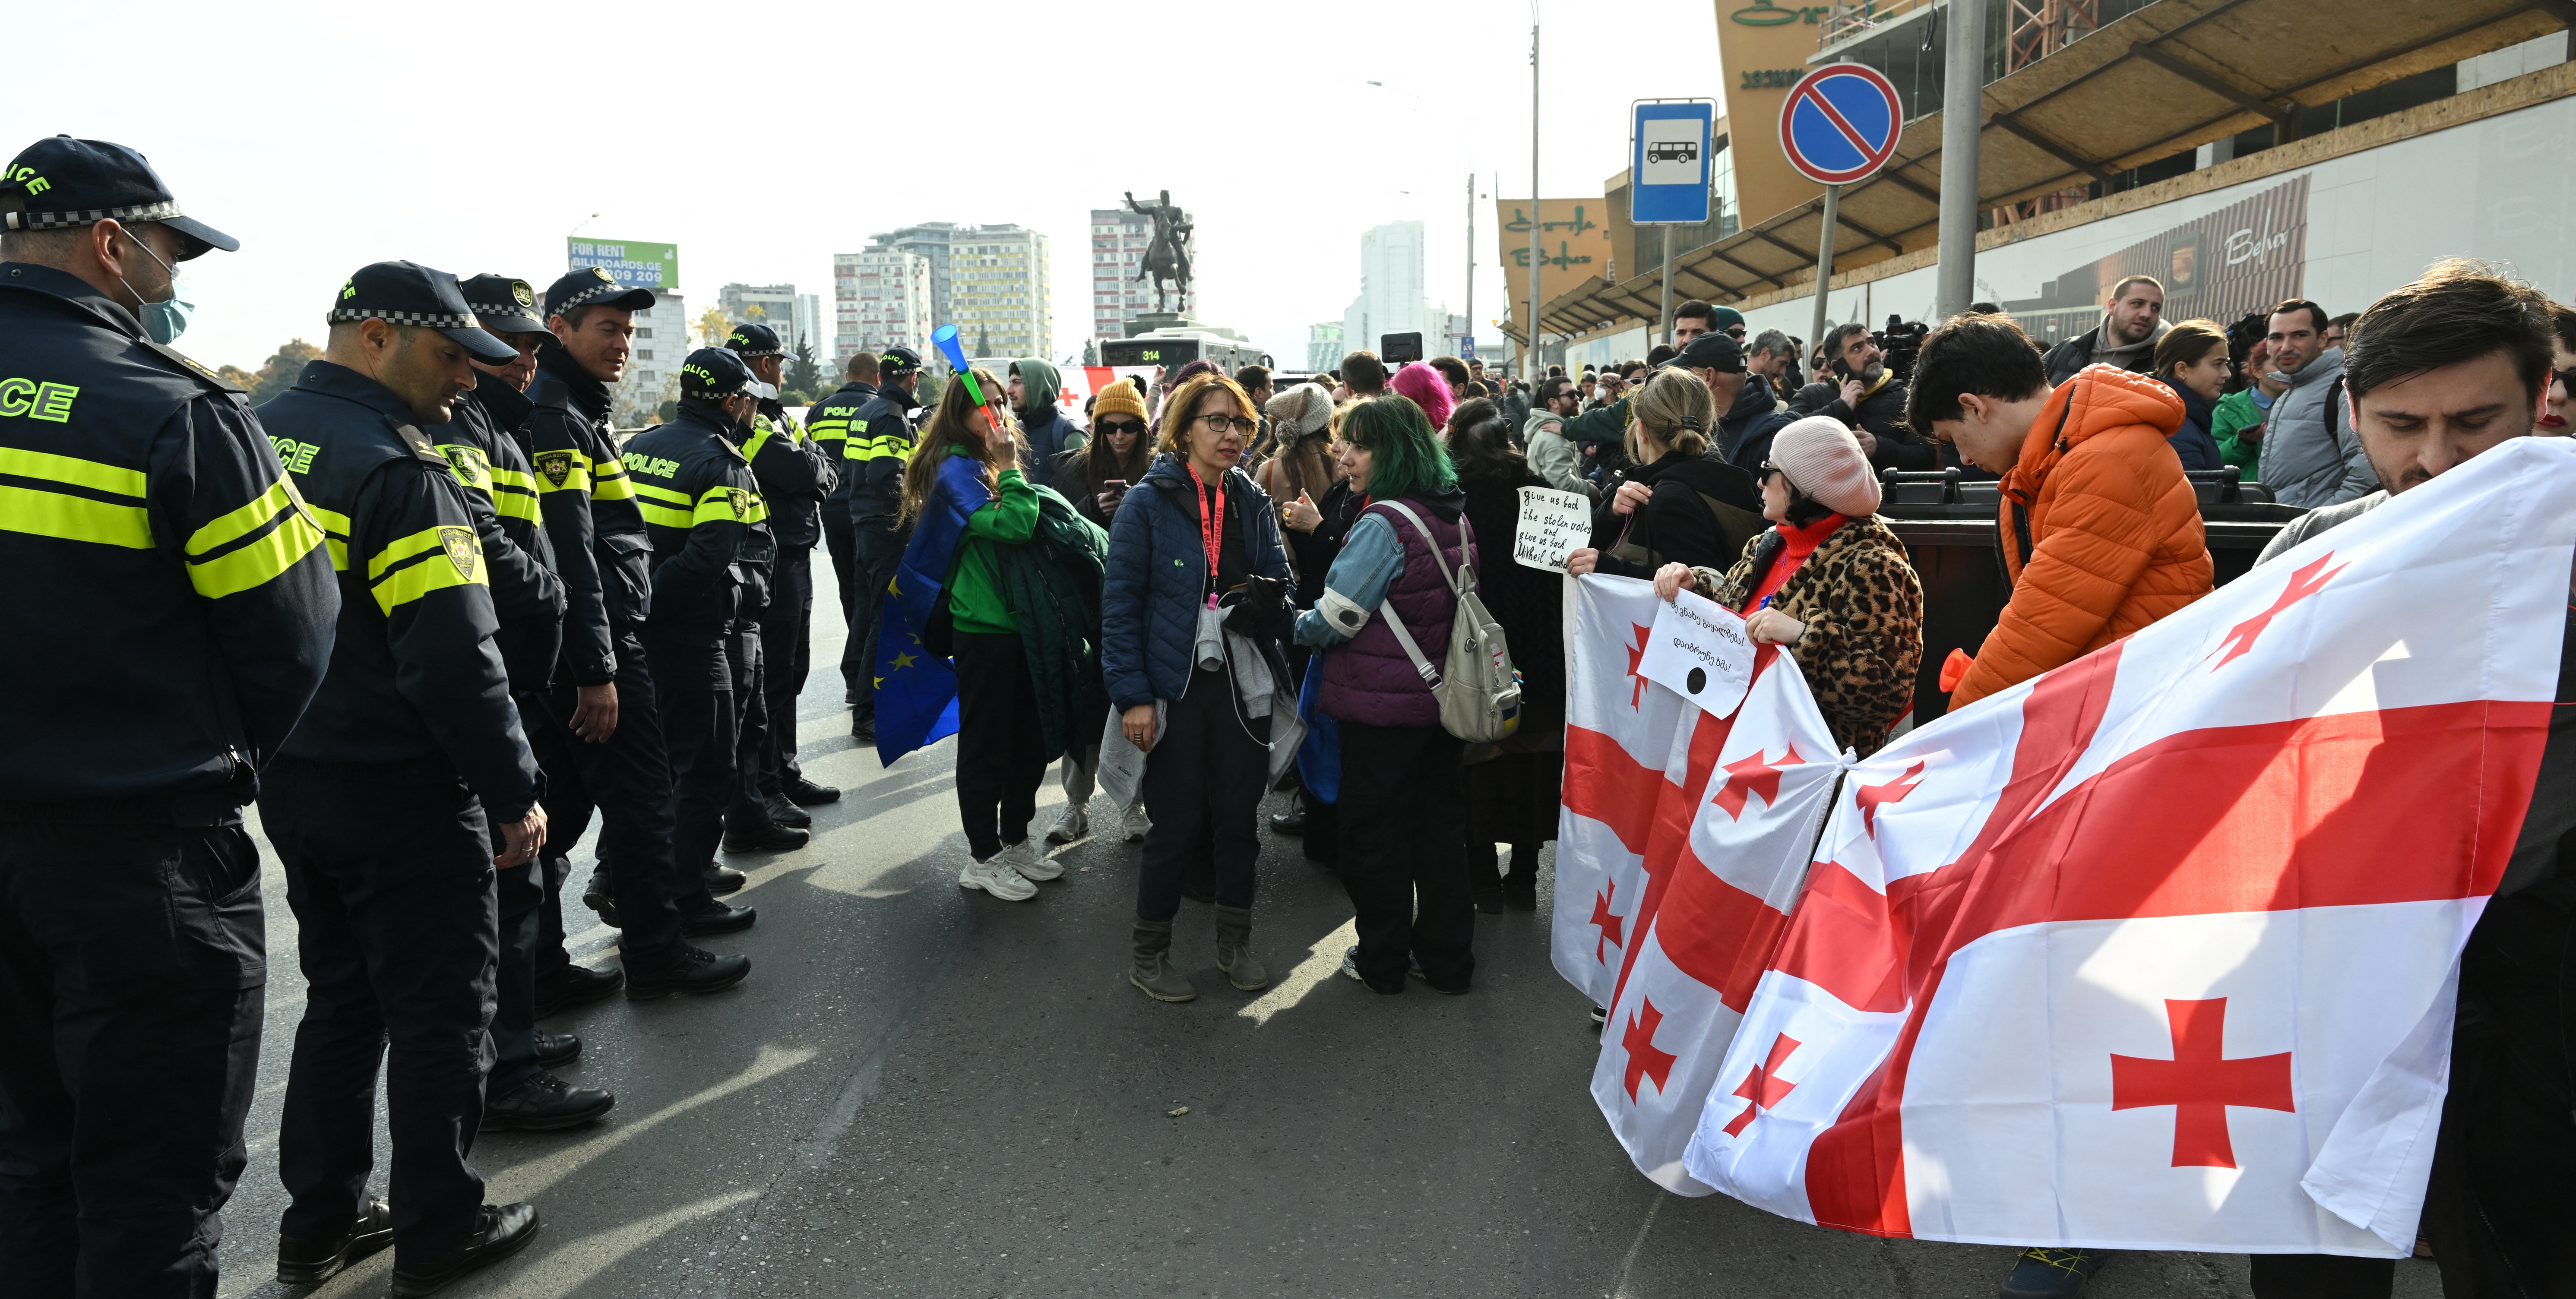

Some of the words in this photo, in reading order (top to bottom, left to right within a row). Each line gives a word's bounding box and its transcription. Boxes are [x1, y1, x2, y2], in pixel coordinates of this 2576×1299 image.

[2224, 207, 2289, 267] Belux
[572, 242, 594, 256] FOR
[597, 244, 625, 258] RENT
[572, 257, 662, 271] BILLBOARDS.GE
[636, 271, 662, 282] 209
[728, 333, 750, 345] OLICE
[1142, 351, 1160, 360] 314
[849, 420, 868, 433] OLICE
[622, 452, 680, 479] POLICE
[1524, 490, 1545, 506] give
[1550, 497, 1560, 505] us
[1563, 495, 1579, 510] back
[1523, 509, 1538, 521] the
[1544, 513, 1568, 528] stolen
[1570, 521, 1592, 534] votes
[1519, 532, 1537, 544] give
[1539, 538, 1547, 546] us
[1550, 537, 1567, 549] back
[1544, 528, 1559, 537] and
[1679, 607, 1701, 625] ვნახე
[1703, 619, 1745, 646] გაყალბება!
[1674, 638, 1715, 666] დაიბრუნე
[1716, 656, 1731, 673] ხმა!
